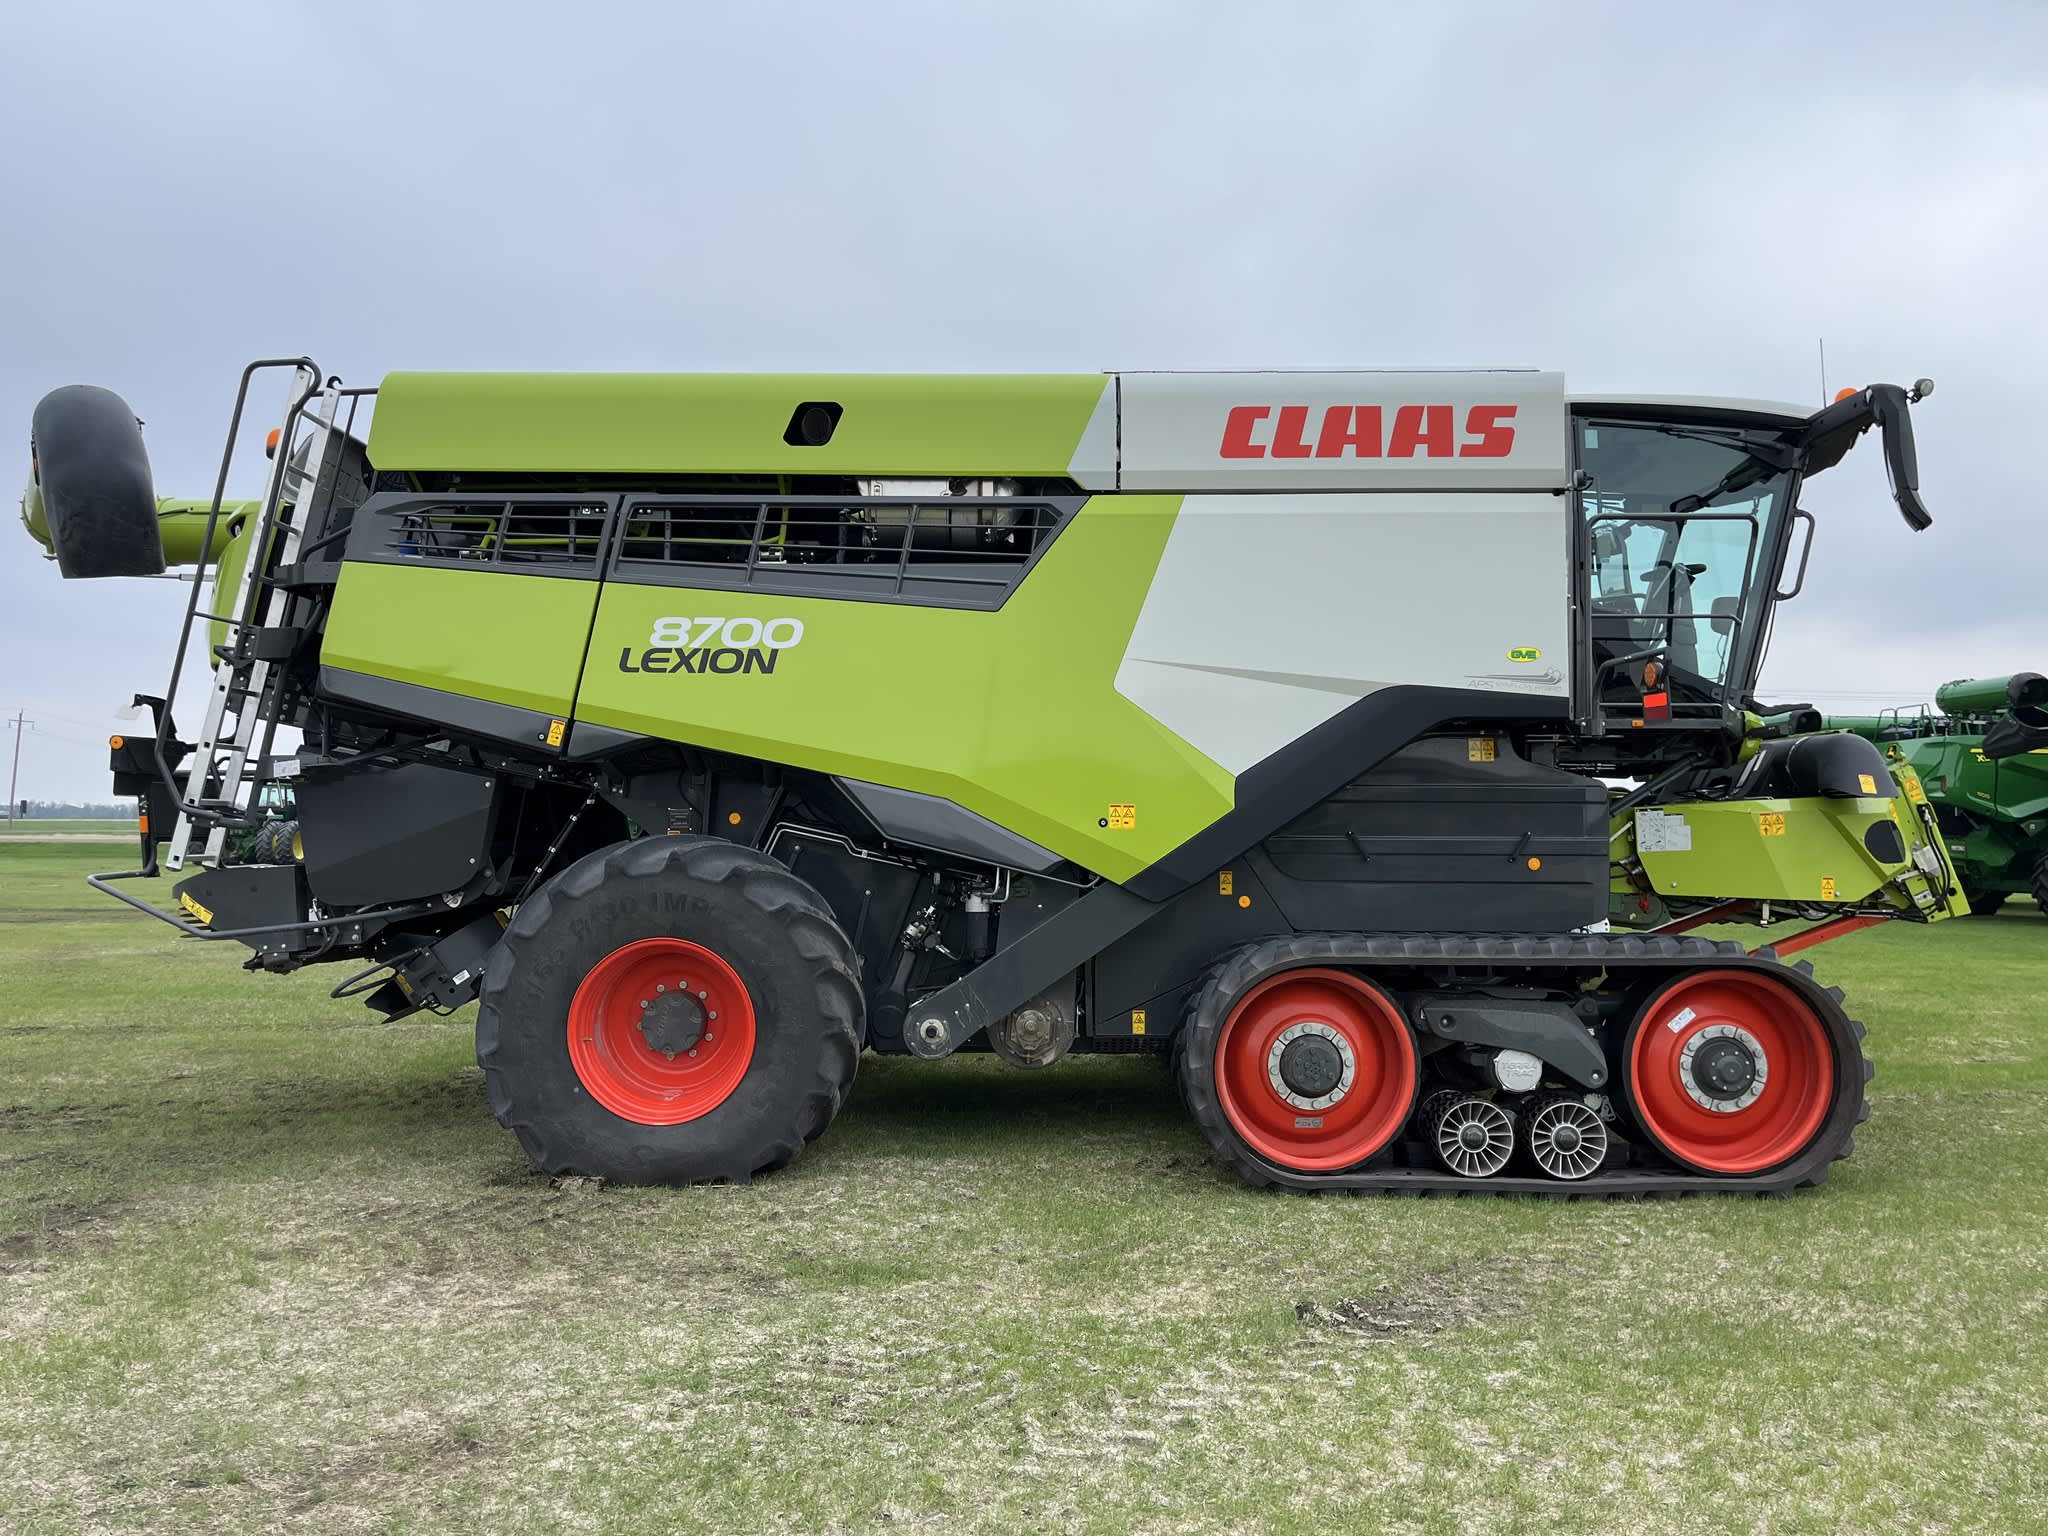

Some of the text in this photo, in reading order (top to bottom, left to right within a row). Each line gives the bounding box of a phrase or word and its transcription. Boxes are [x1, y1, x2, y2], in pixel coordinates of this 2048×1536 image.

[1219, 405, 1518, 458] CLAAS
[650, 616, 805, 649] 8700
[619, 647, 779, 674] LEXION
